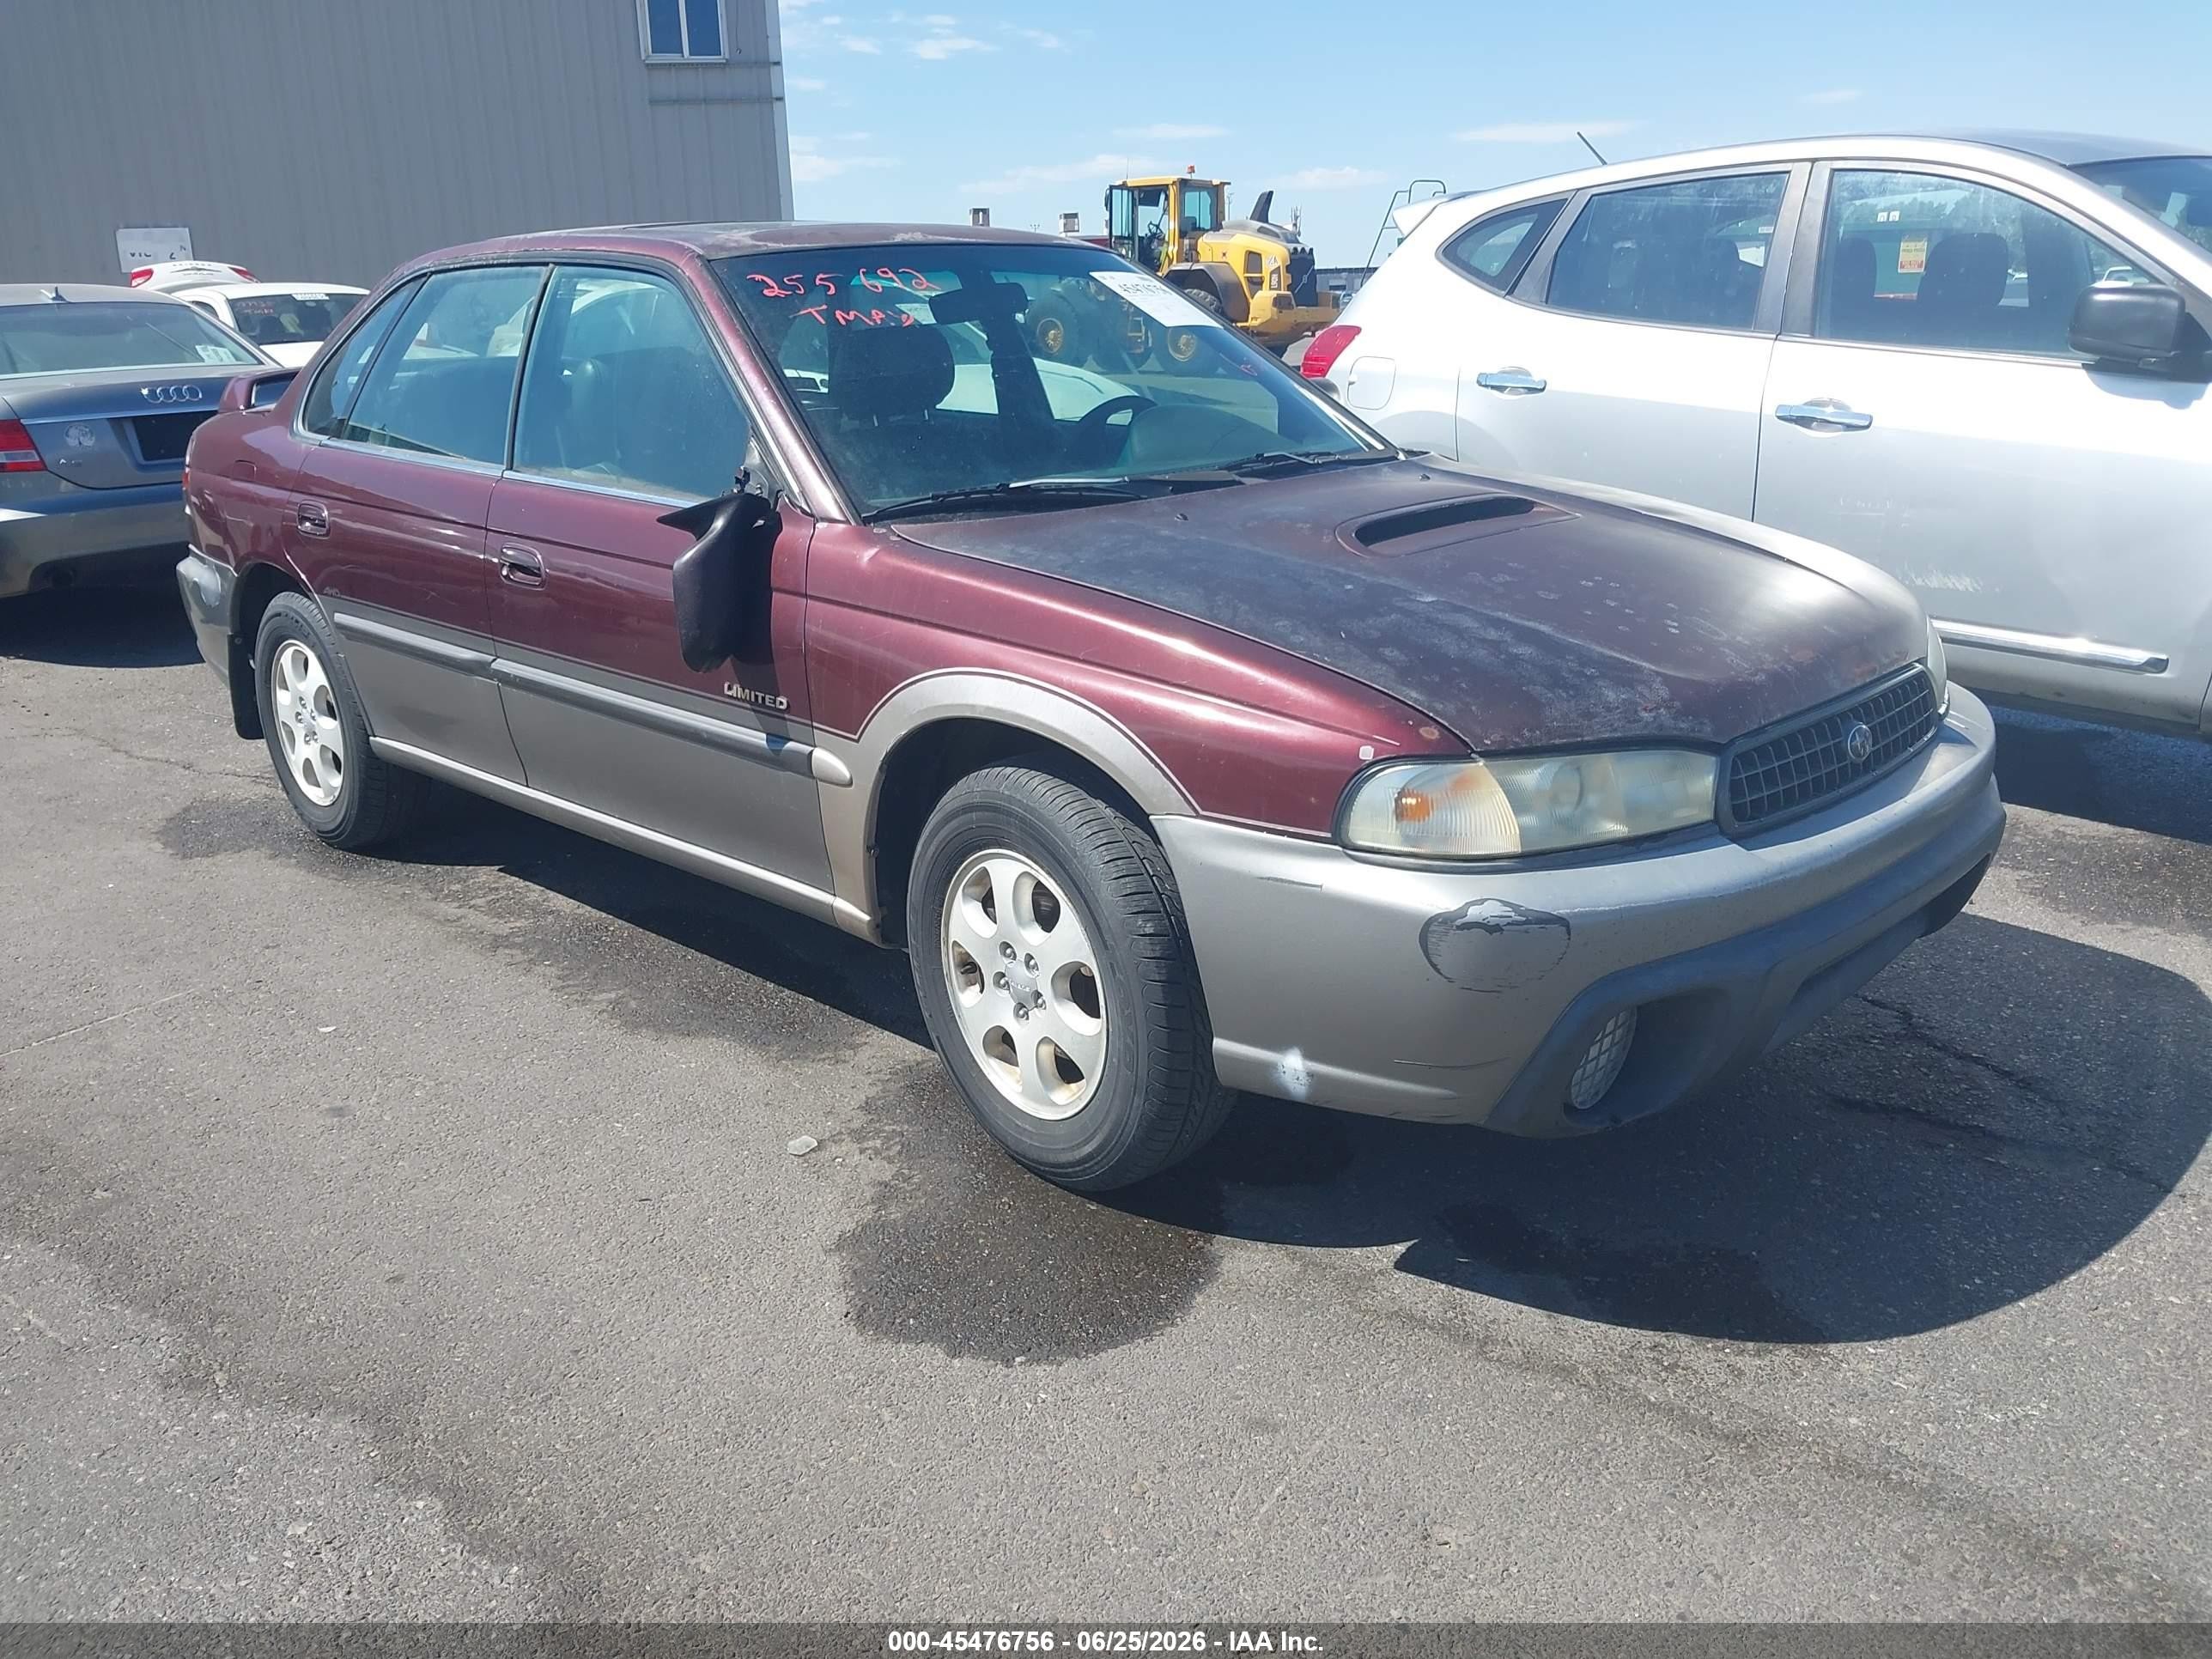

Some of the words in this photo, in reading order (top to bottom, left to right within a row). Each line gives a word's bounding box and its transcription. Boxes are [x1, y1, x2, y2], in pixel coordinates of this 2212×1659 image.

[745, 273, 844, 297] 255
[860, 267, 942, 297] 692
[723, 681, 788, 710] LIMITED
